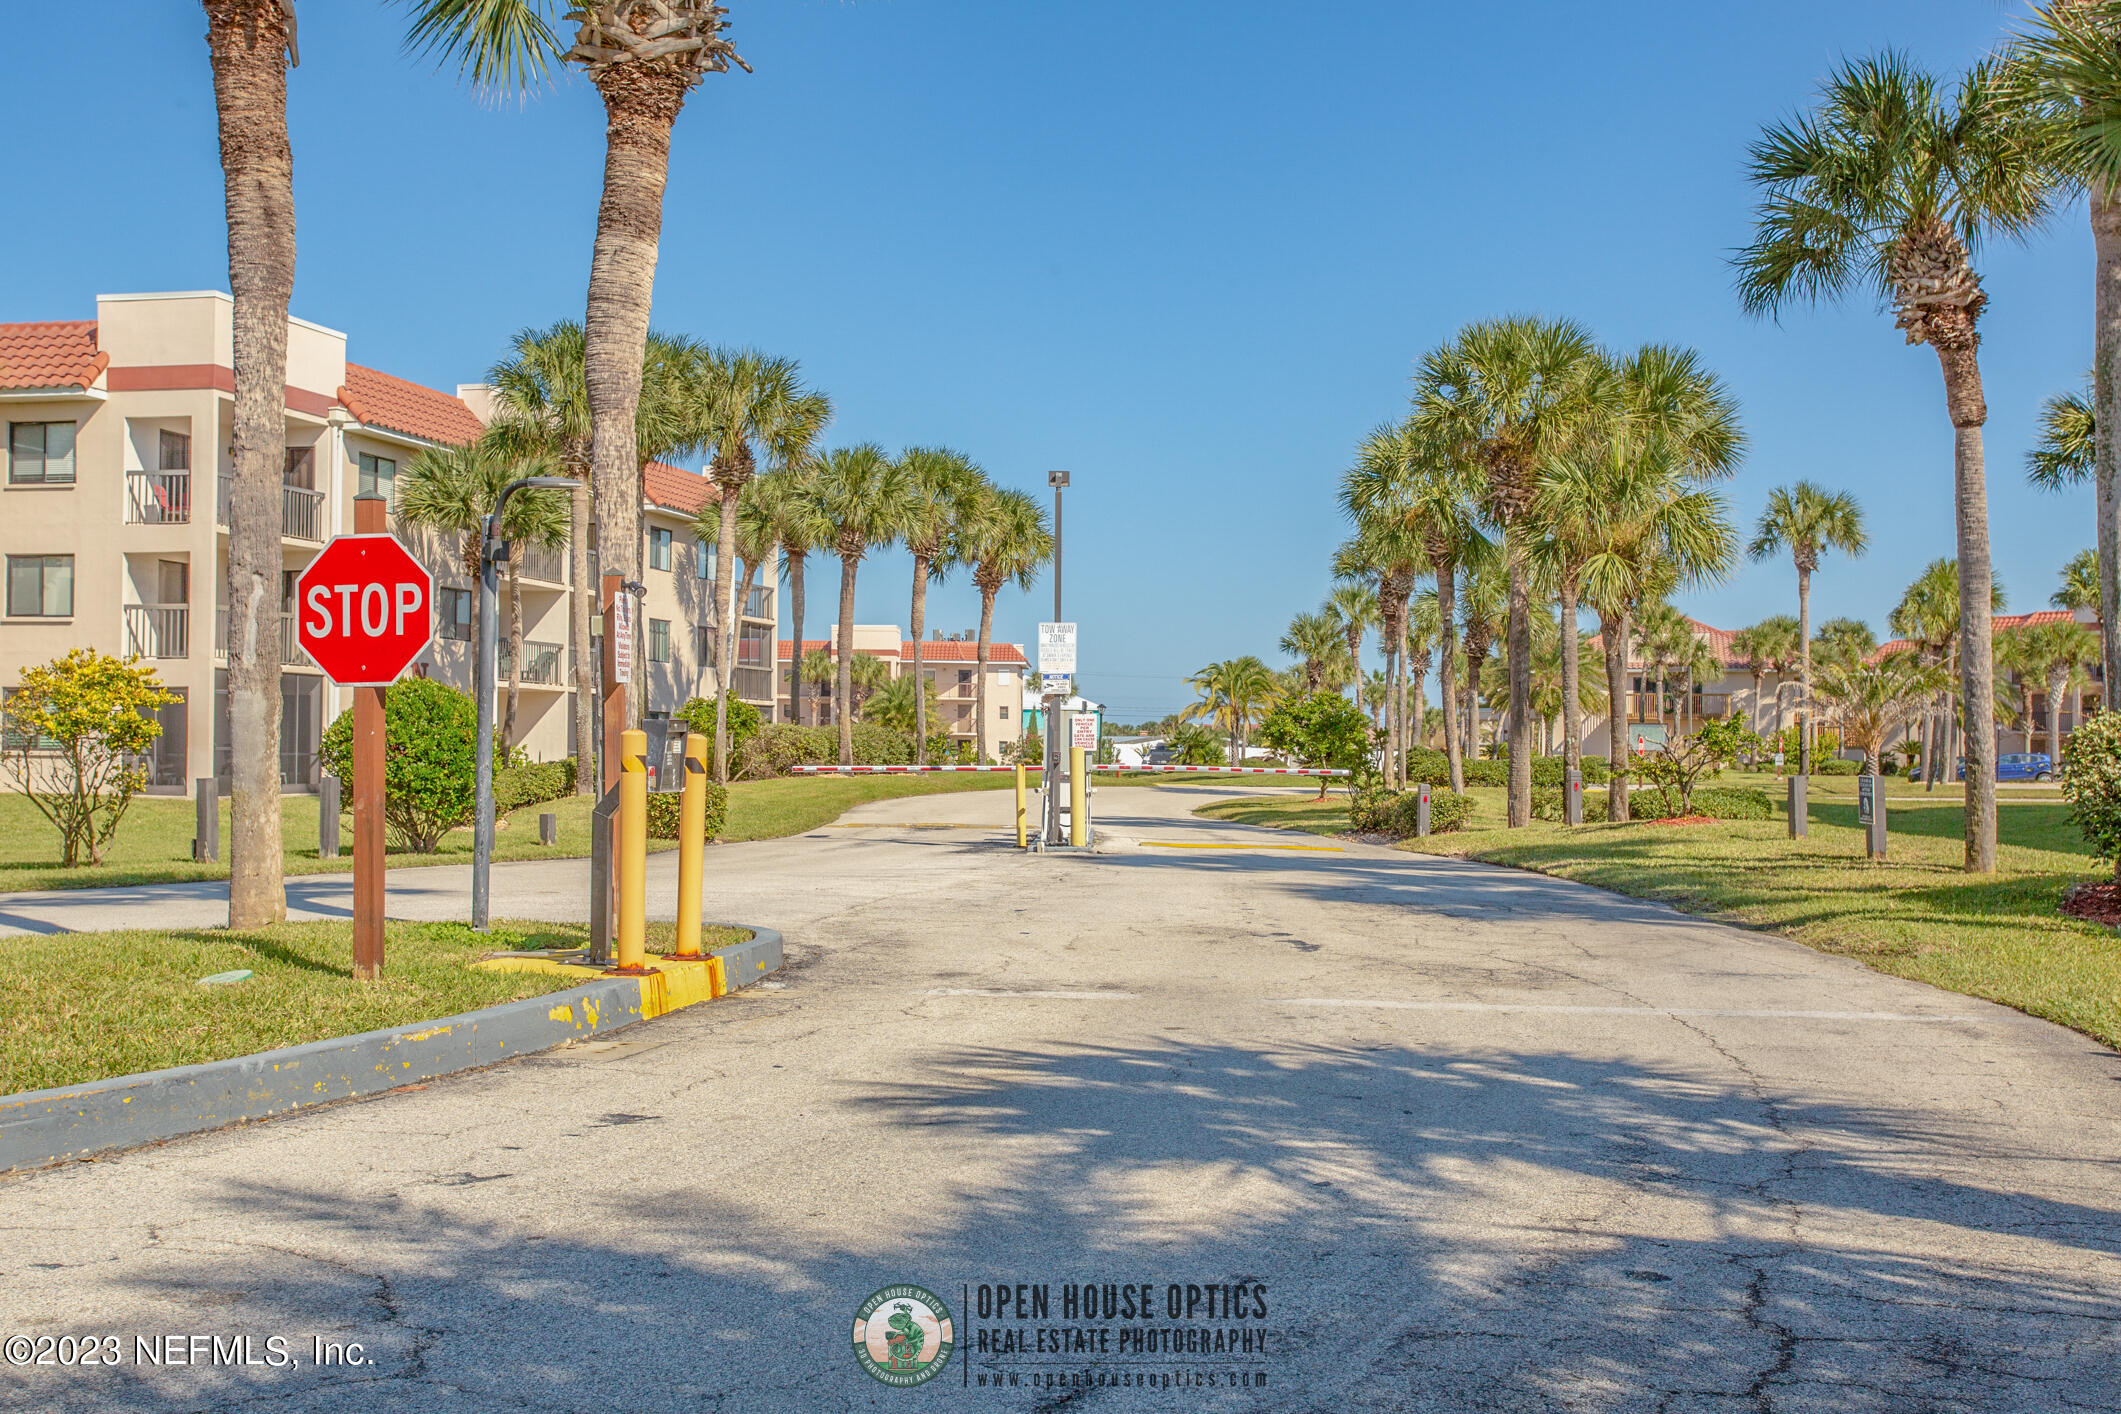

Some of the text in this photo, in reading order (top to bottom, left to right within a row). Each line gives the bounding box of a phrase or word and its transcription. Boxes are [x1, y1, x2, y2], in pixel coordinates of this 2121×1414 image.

[306, 582, 423, 639] STOP
[1041, 625, 1074, 633] TOW AWAY
[1049, 634, 1066, 643] ZONE
